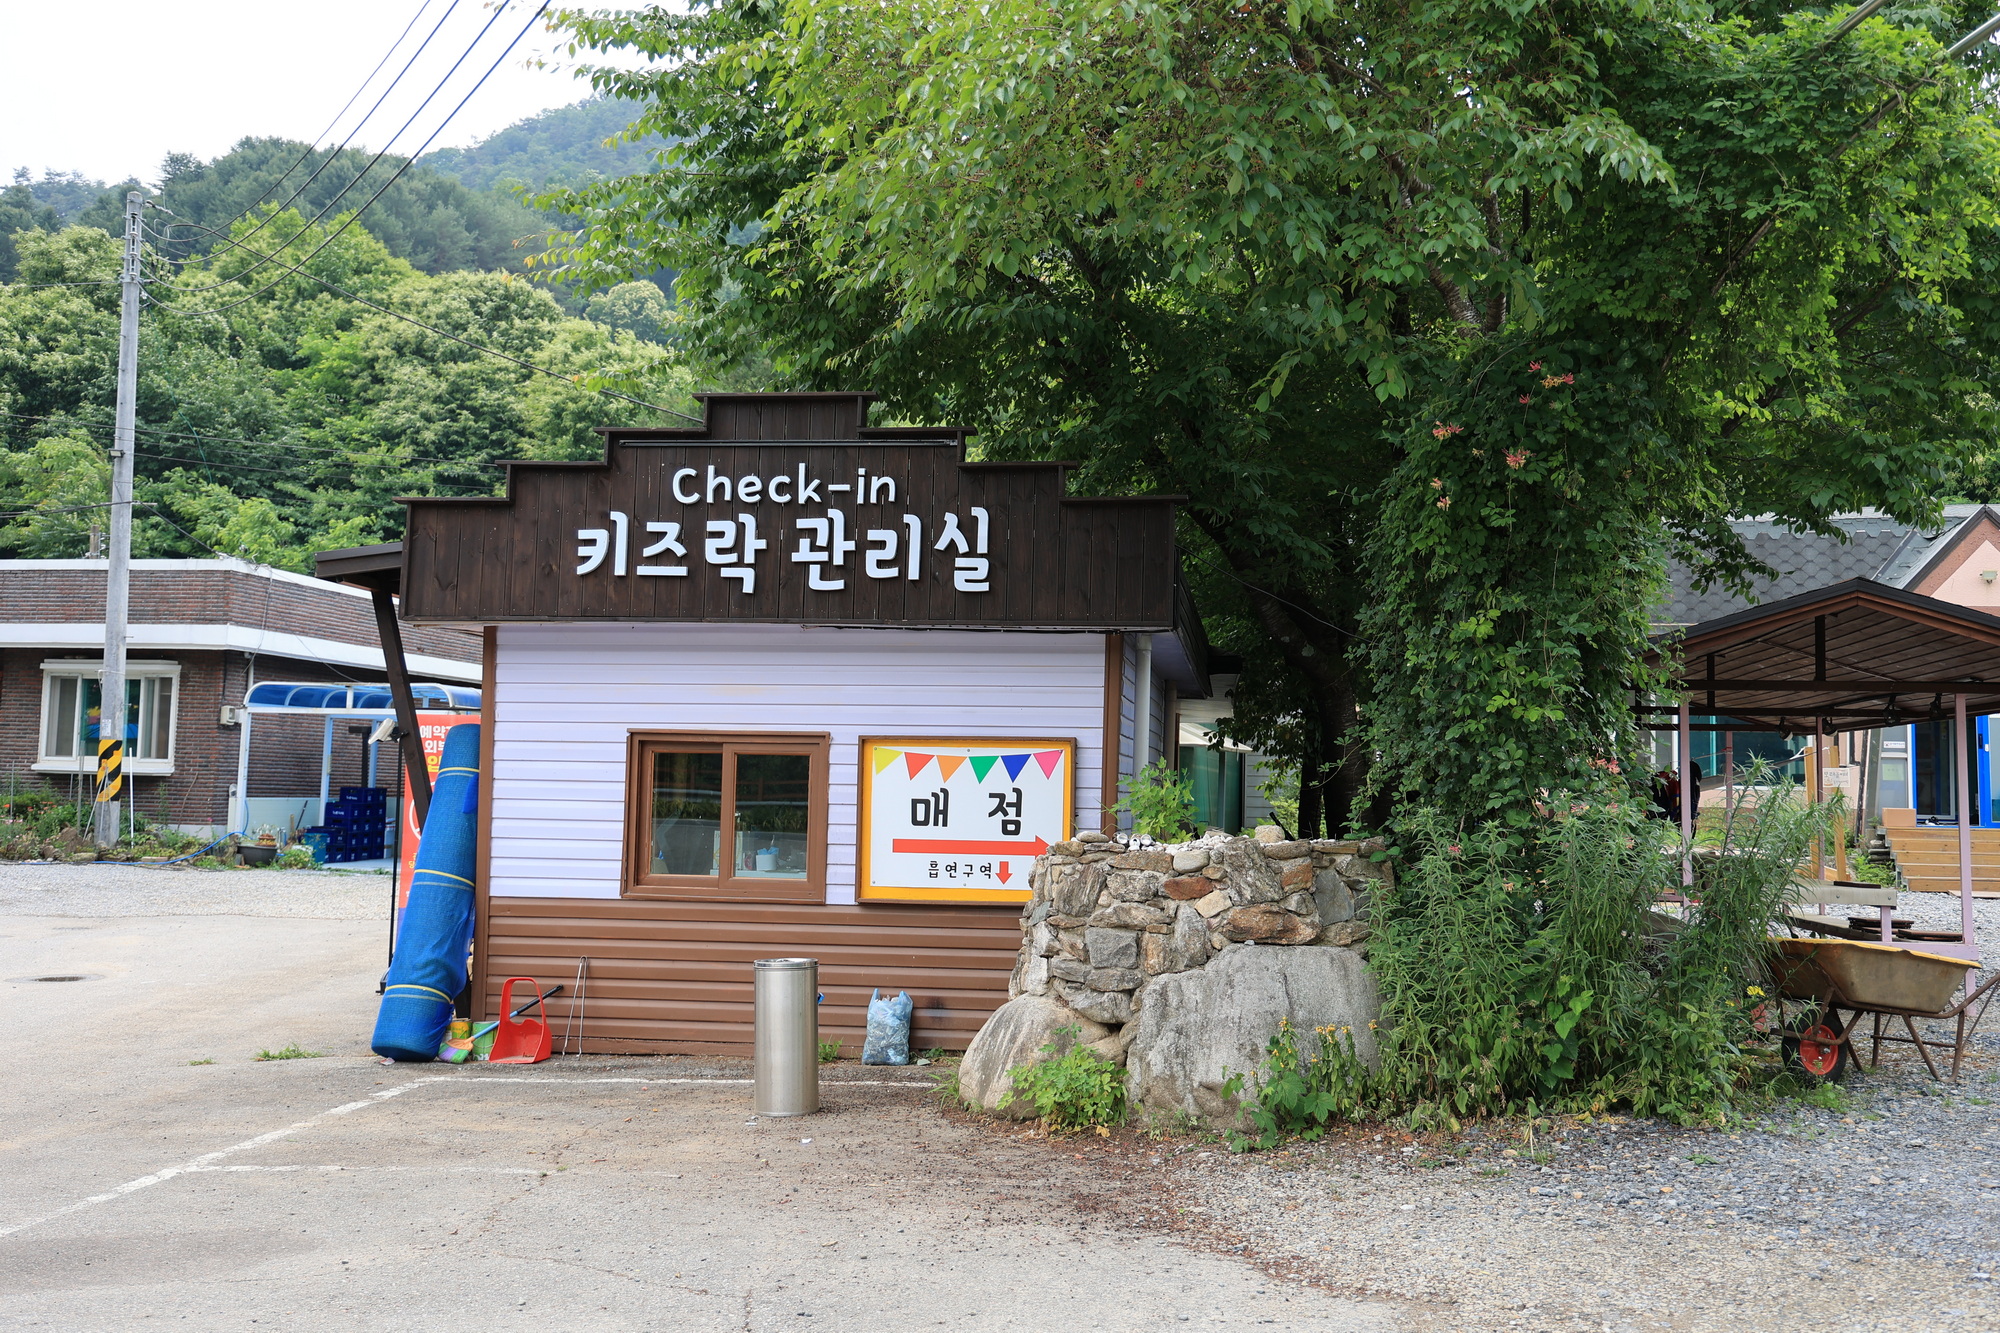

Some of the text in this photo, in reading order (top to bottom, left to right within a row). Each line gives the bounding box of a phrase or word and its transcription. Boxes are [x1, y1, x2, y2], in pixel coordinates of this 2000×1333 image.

[672, 462, 896, 505] Check-in
[576, 507, 990, 594] 키즈락 관리실
[420, 725, 453, 739] 예약
[928, 860, 992, 879] 흡연구역
